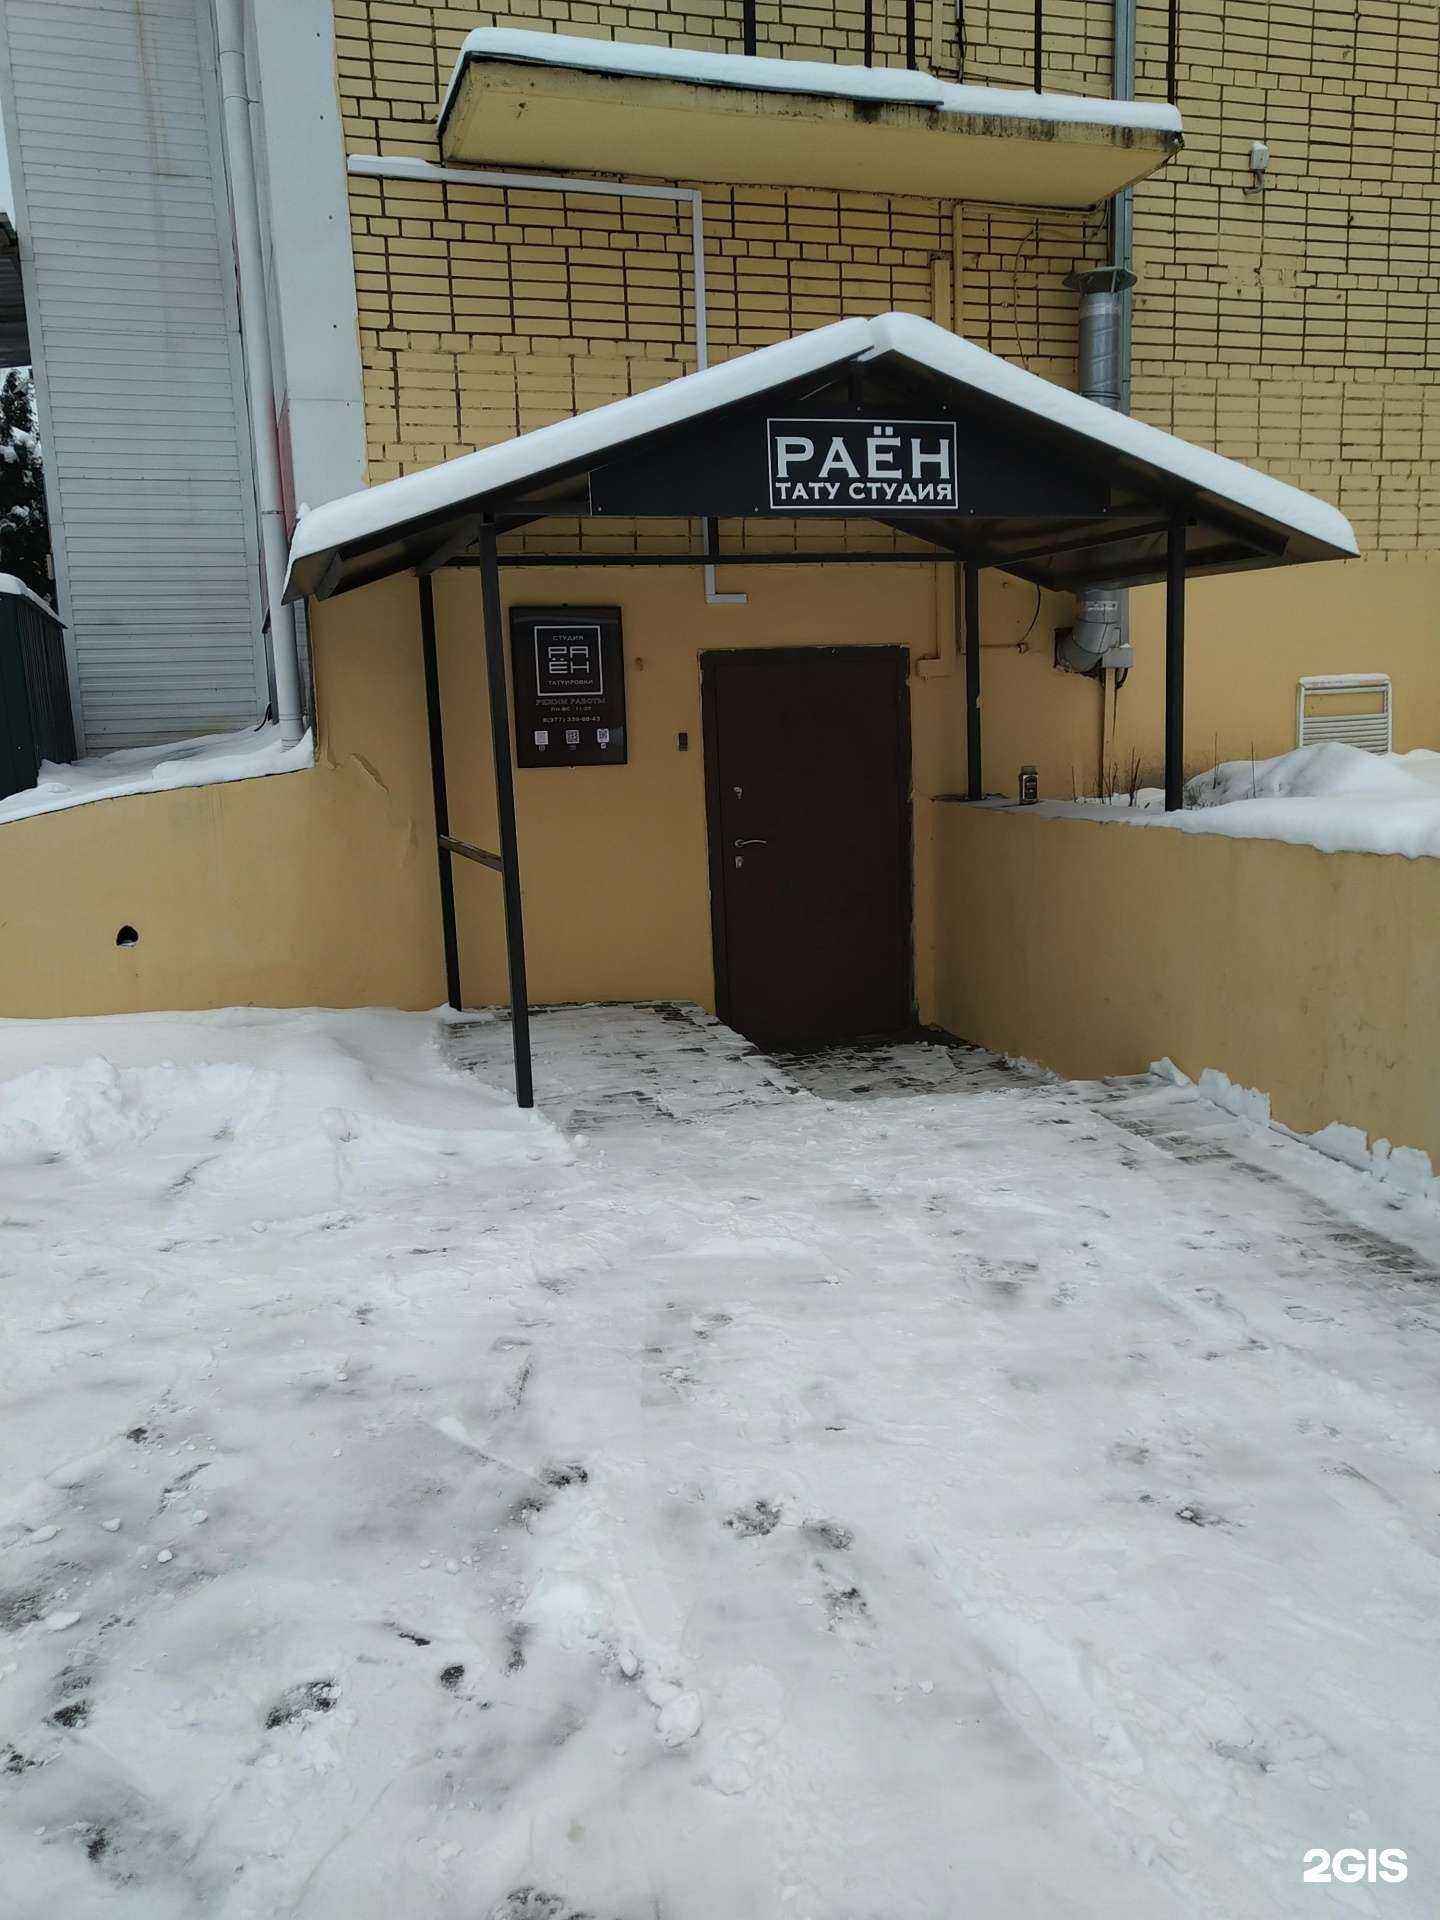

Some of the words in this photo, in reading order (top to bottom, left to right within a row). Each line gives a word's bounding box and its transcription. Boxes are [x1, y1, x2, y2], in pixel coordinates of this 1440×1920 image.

[775, 426, 950, 479] РАЁН
[775, 482, 841, 500] ТАТУ
[848, 482, 952, 502] СТУДИЯ
